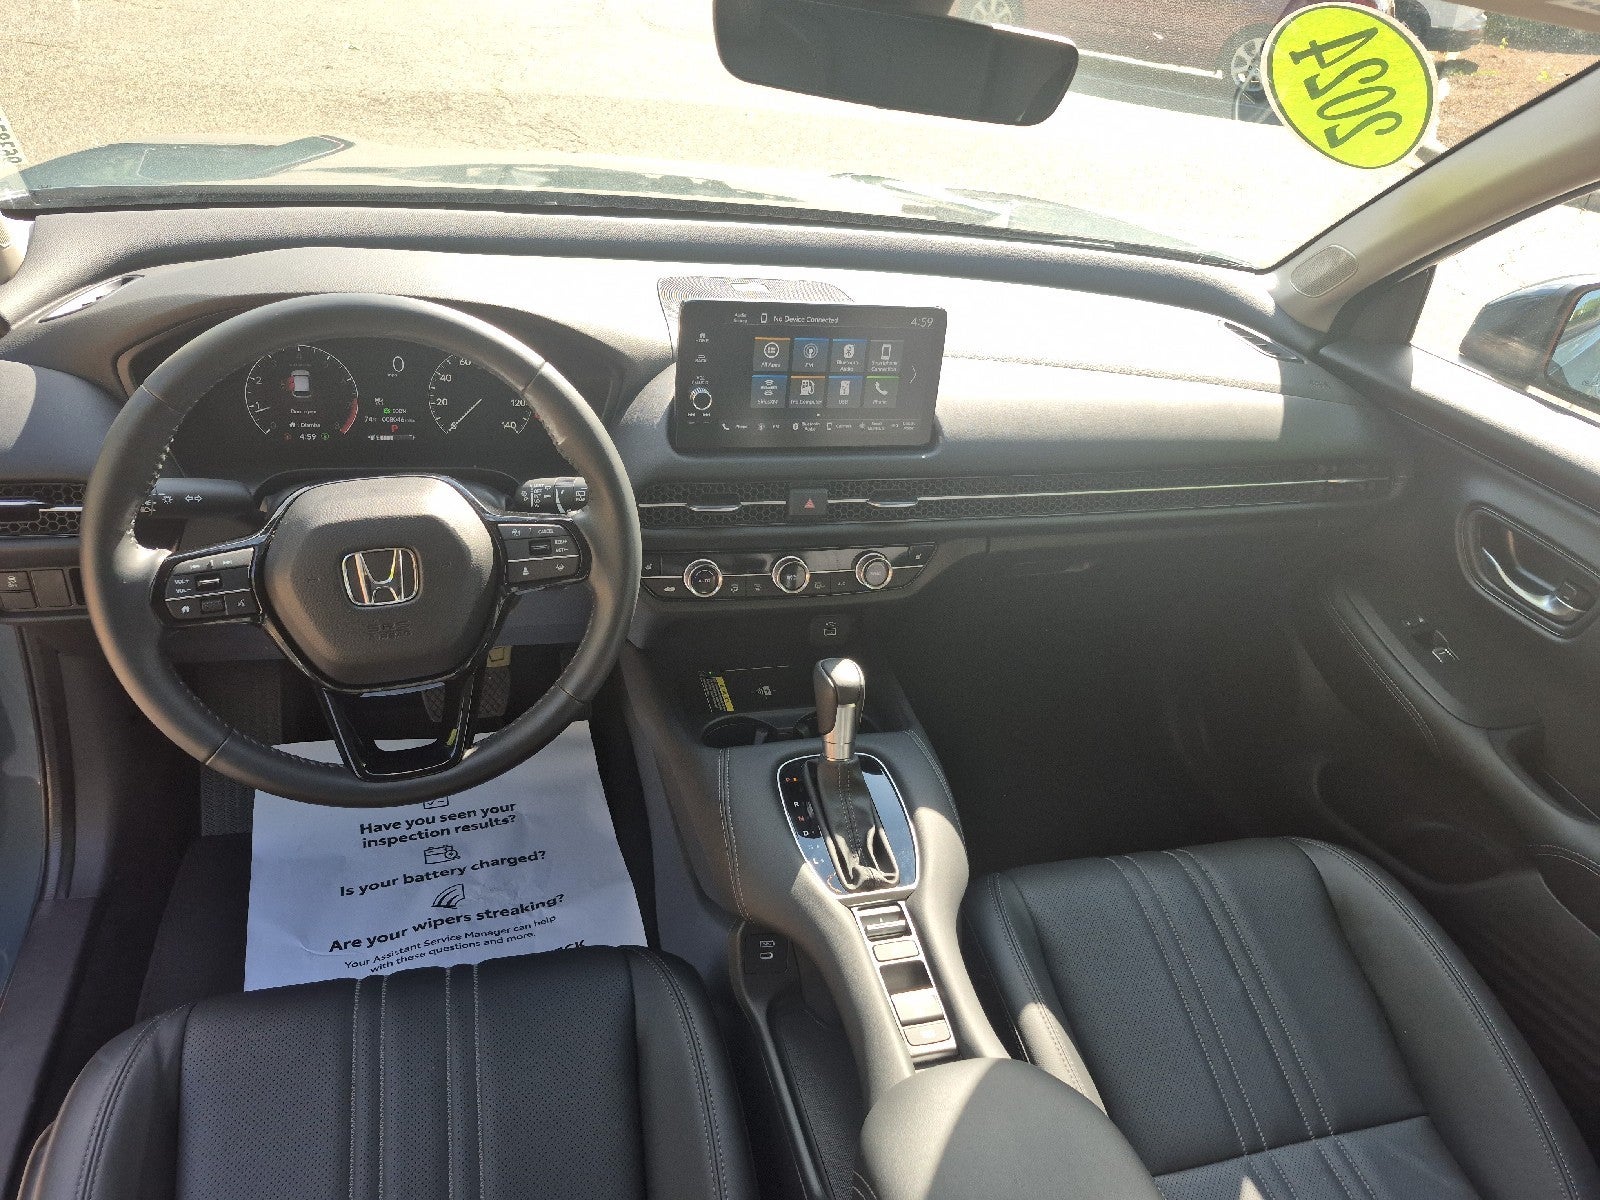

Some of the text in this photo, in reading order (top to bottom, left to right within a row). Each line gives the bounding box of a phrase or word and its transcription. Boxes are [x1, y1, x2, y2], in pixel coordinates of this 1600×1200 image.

[806, 316, 839, 324] Connected
[910, 317, 934, 328] 4:59
[392, 355, 405, 372] 0
[459, 358, 472, 366] 60
[256, 376, 262, 385] 2
[440, 374, 452, 382] 40
[436, 398, 448, 406] 20
[510, 399, 526, 407] 120
[391, 424, 399, 433] P
[501, 421, 517, 430] 140
[299, 433, 317, 441] 4:59
[359, 803, 517, 835] Have you seen your
[362, 814, 517, 849] inspection results?
[340, 850, 547, 897] Is your battery charged?
[328, 893, 565, 953] Are your wipers streaking?
[344, 915, 557, 969] Your Assistant Service Manager can help
[370, 932, 537, 973] with these questions and more.
